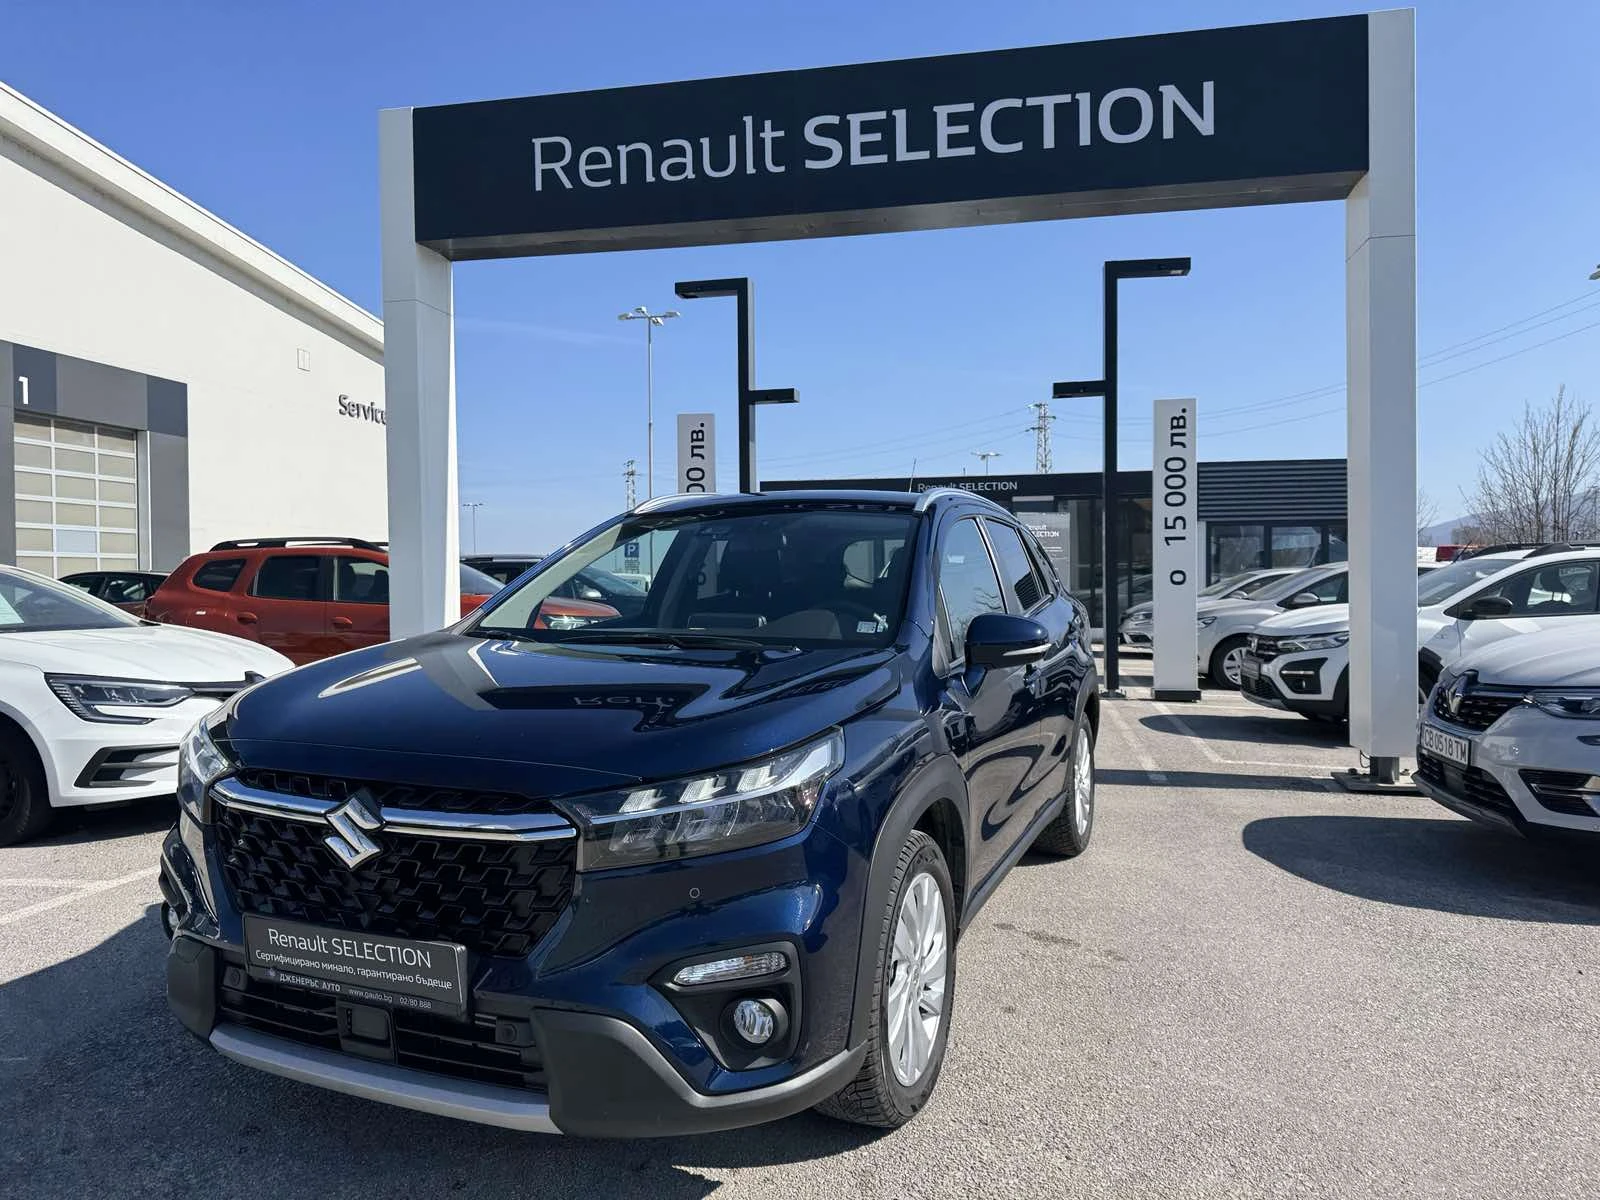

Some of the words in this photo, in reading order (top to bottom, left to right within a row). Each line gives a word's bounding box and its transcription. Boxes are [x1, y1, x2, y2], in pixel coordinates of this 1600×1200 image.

[531, 116, 785, 191] Renault
[803, 81, 1216, 169] SELECTION
[18, 375, 29, 405] 1
[690, 422, 705, 460] лв.
[1170, 408, 1187, 448] лв.
[959, 481, 1018, 491] SELECTION
[1164, 456, 1187, 507] 000
[1164, 516, 1187, 546] 15
[268, 928, 329, 954] Renault
[331, 938, 432, 968] SELECTION
[255, 949, 320, 969] Сертифицирано
[321, 962, 356, 976] минало,
[357, 968, 414, 983] гарантирано
[415, 973, 453, 990] бъдеще
